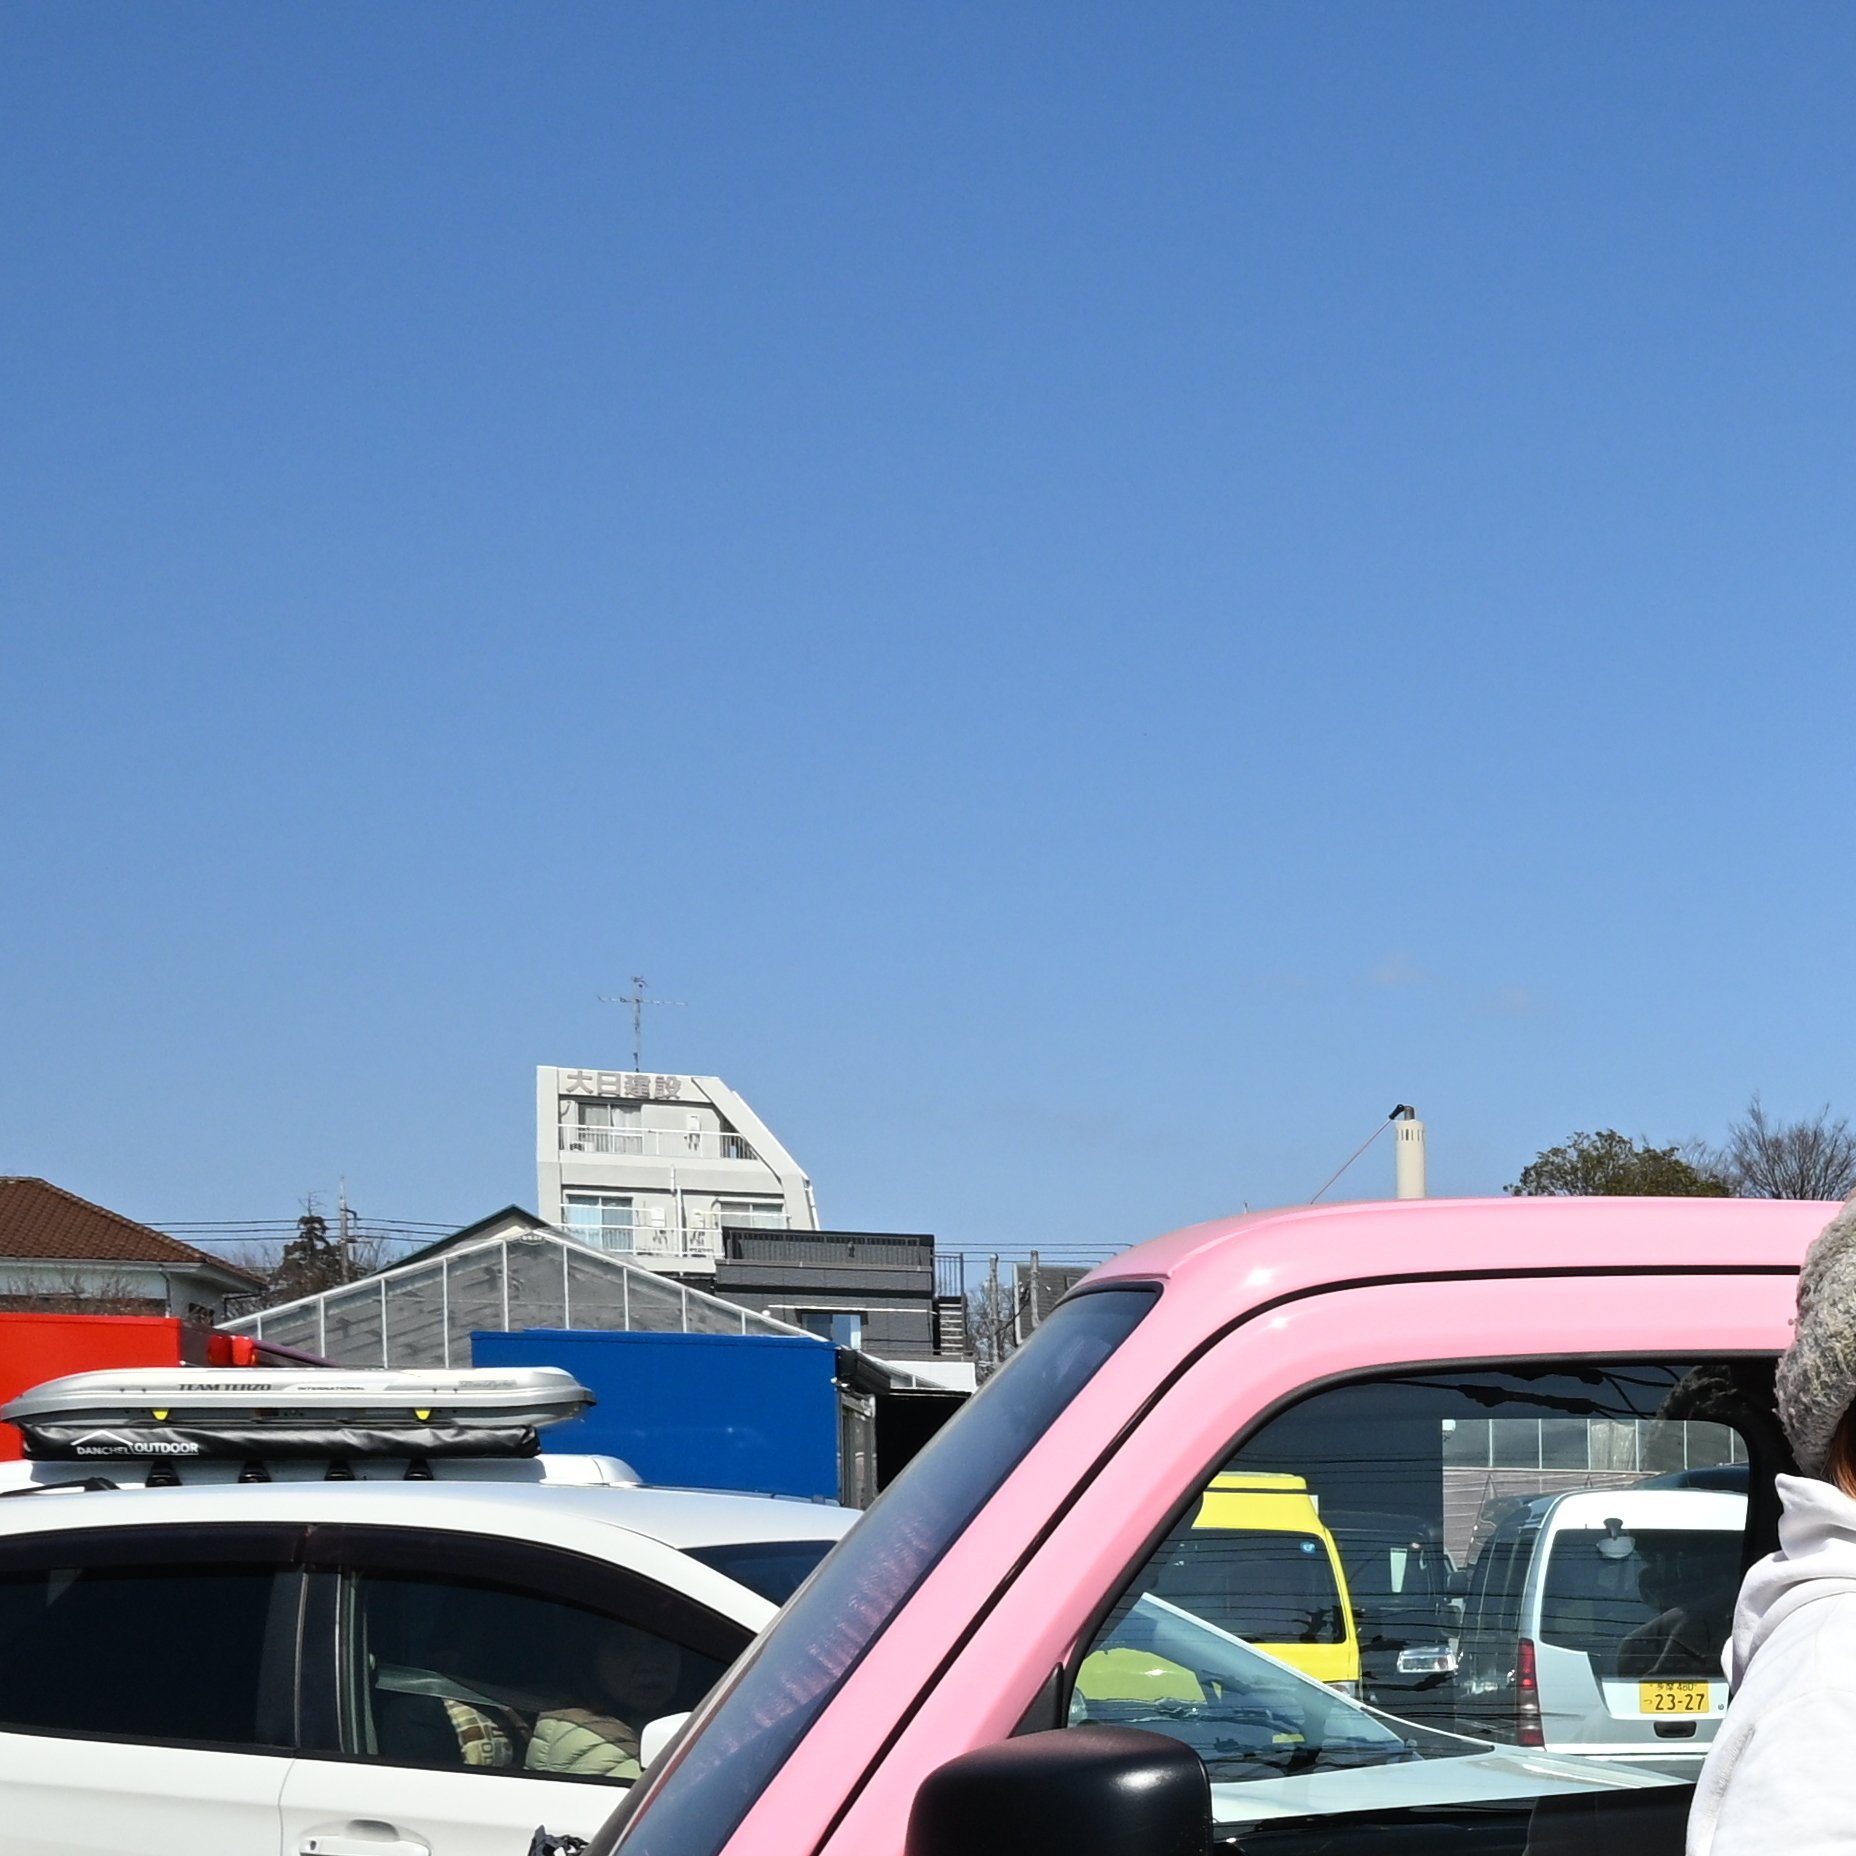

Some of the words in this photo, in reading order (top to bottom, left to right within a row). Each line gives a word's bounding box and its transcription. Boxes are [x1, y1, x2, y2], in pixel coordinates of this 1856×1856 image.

[566, 1071, 682, 1100] 大日建設
[178, 1383, 220, 1391] TEAM
[222, 1383, 272, 1391] TERZO
[134, 1442, 200, 1454] OUTDOOR
[1655, 1693, 1705, 1710] 23-27
